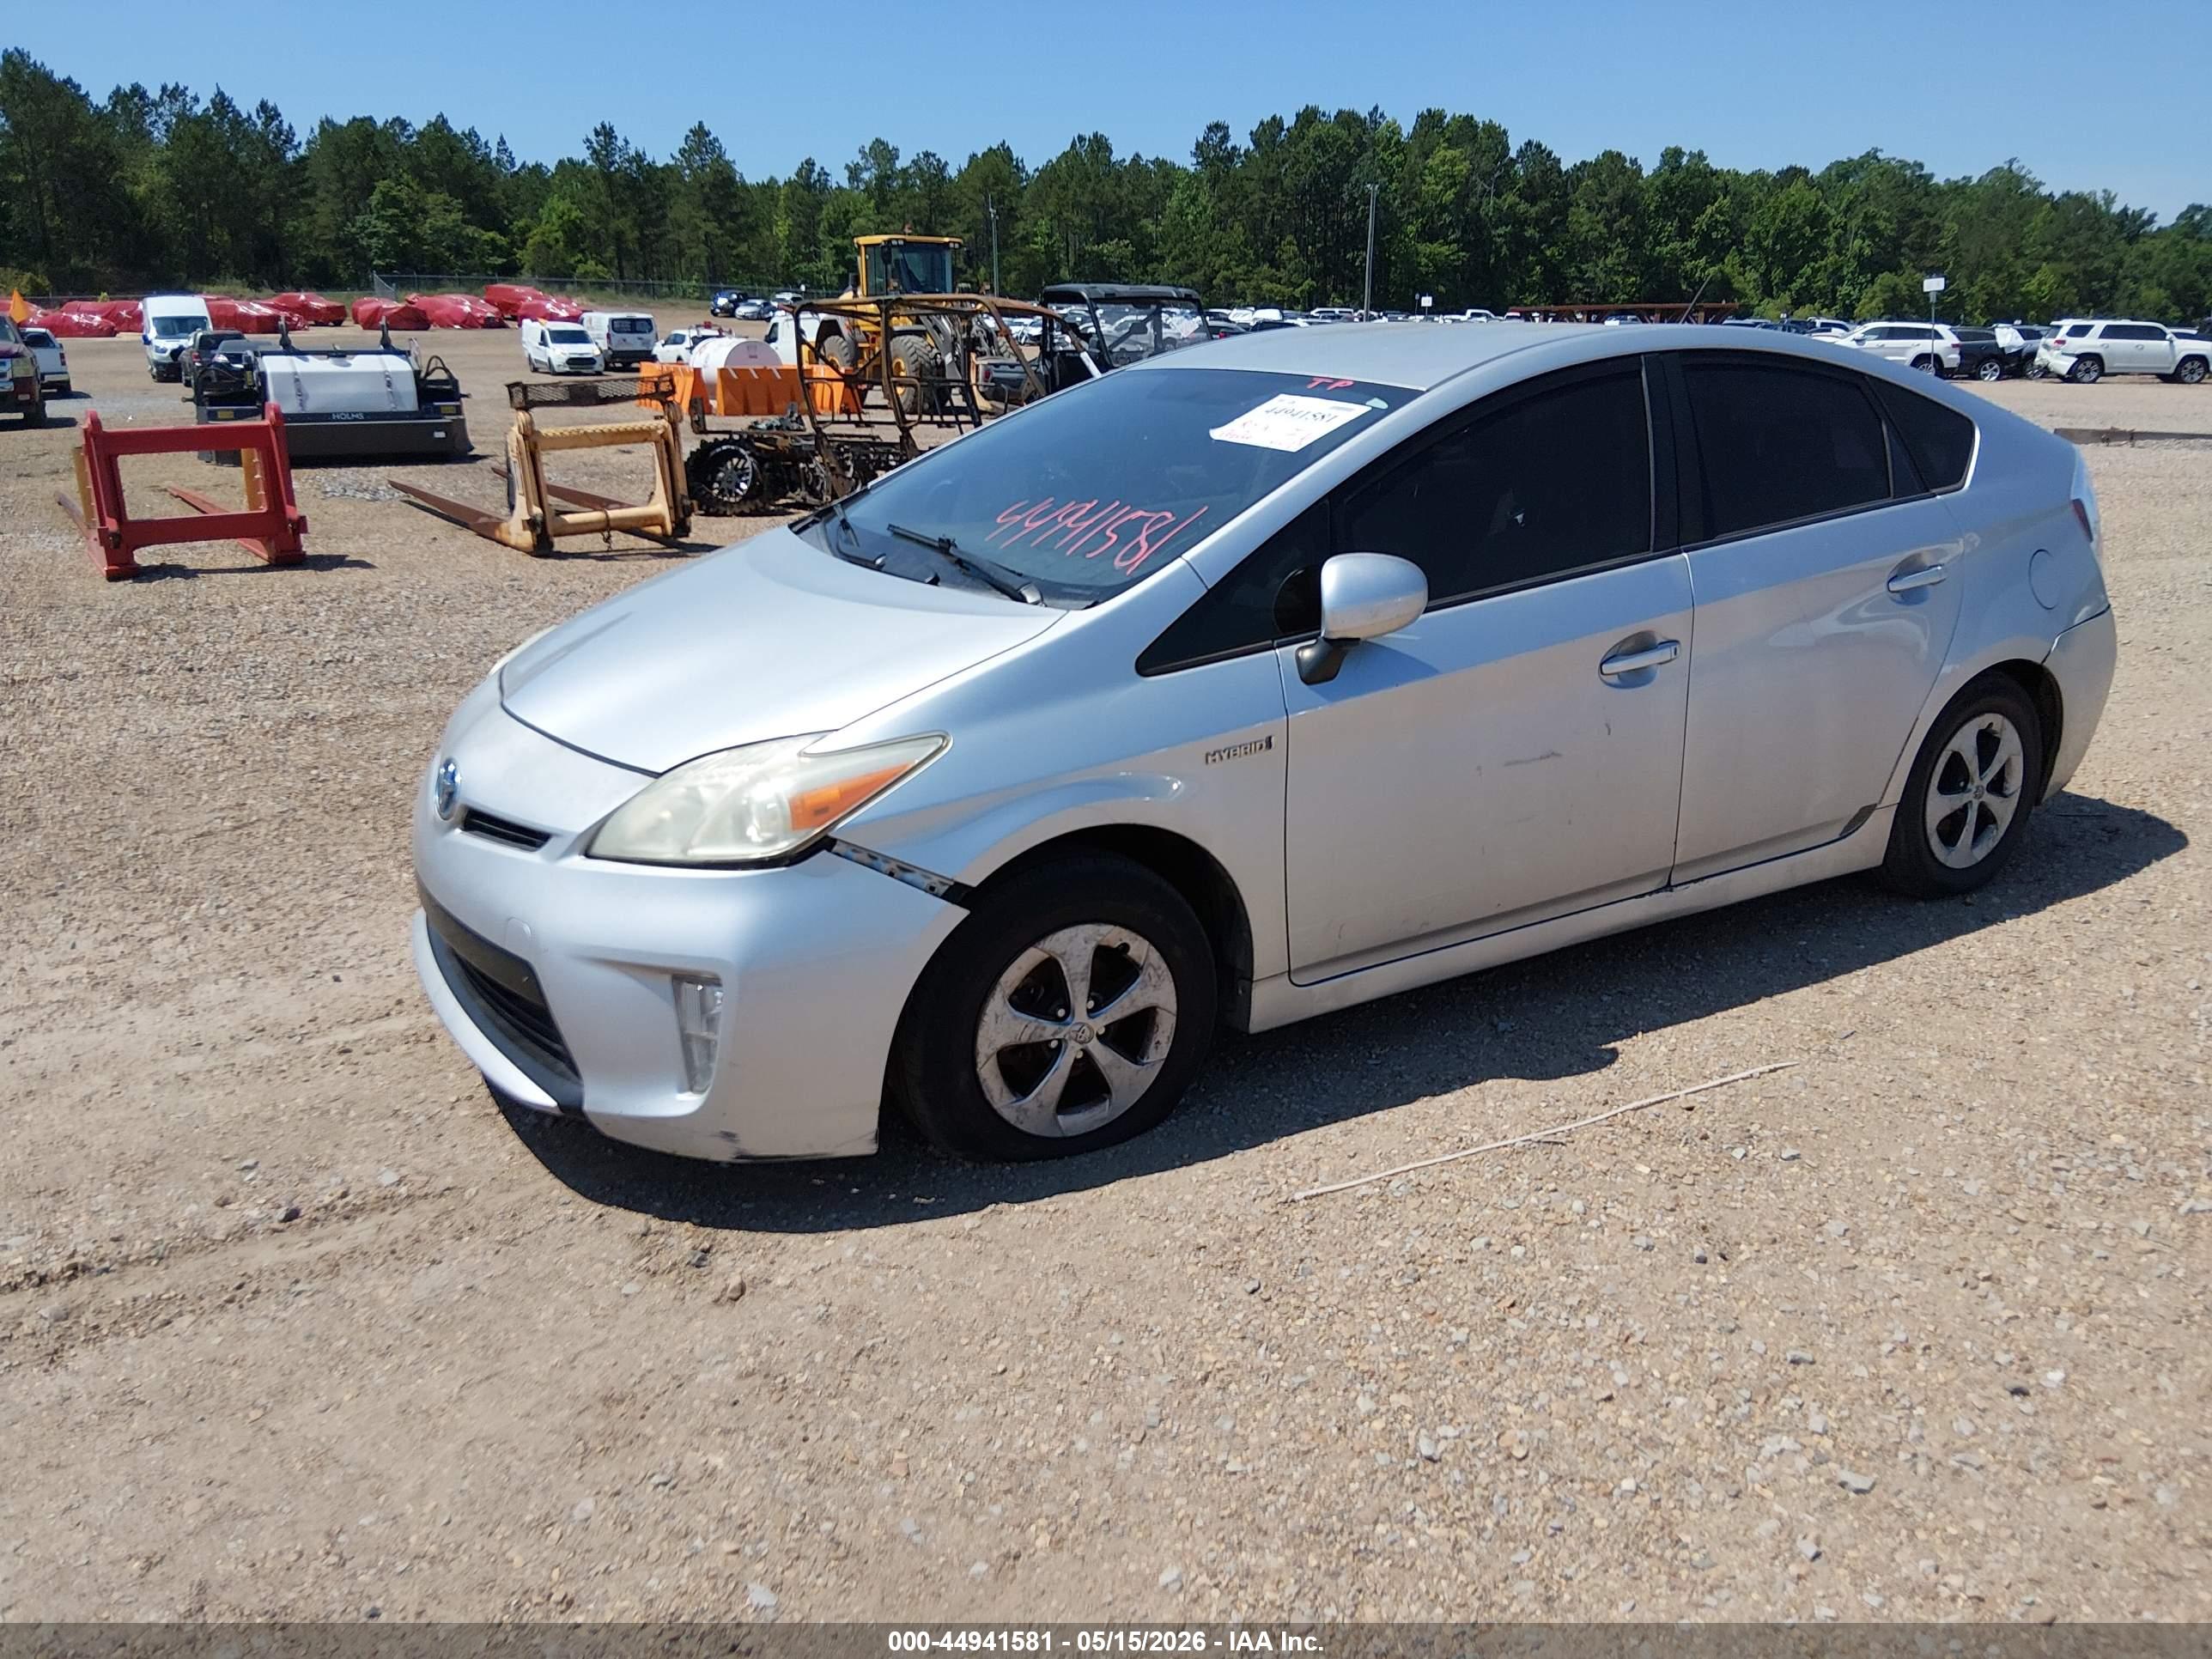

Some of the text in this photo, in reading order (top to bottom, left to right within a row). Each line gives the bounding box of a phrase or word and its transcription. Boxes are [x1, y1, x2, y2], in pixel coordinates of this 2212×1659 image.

[1306, 377, 1354, 391] TP
[985, 497, 1209, 575] 44941581
[1205, 739, 1267, 765] HYBRID
